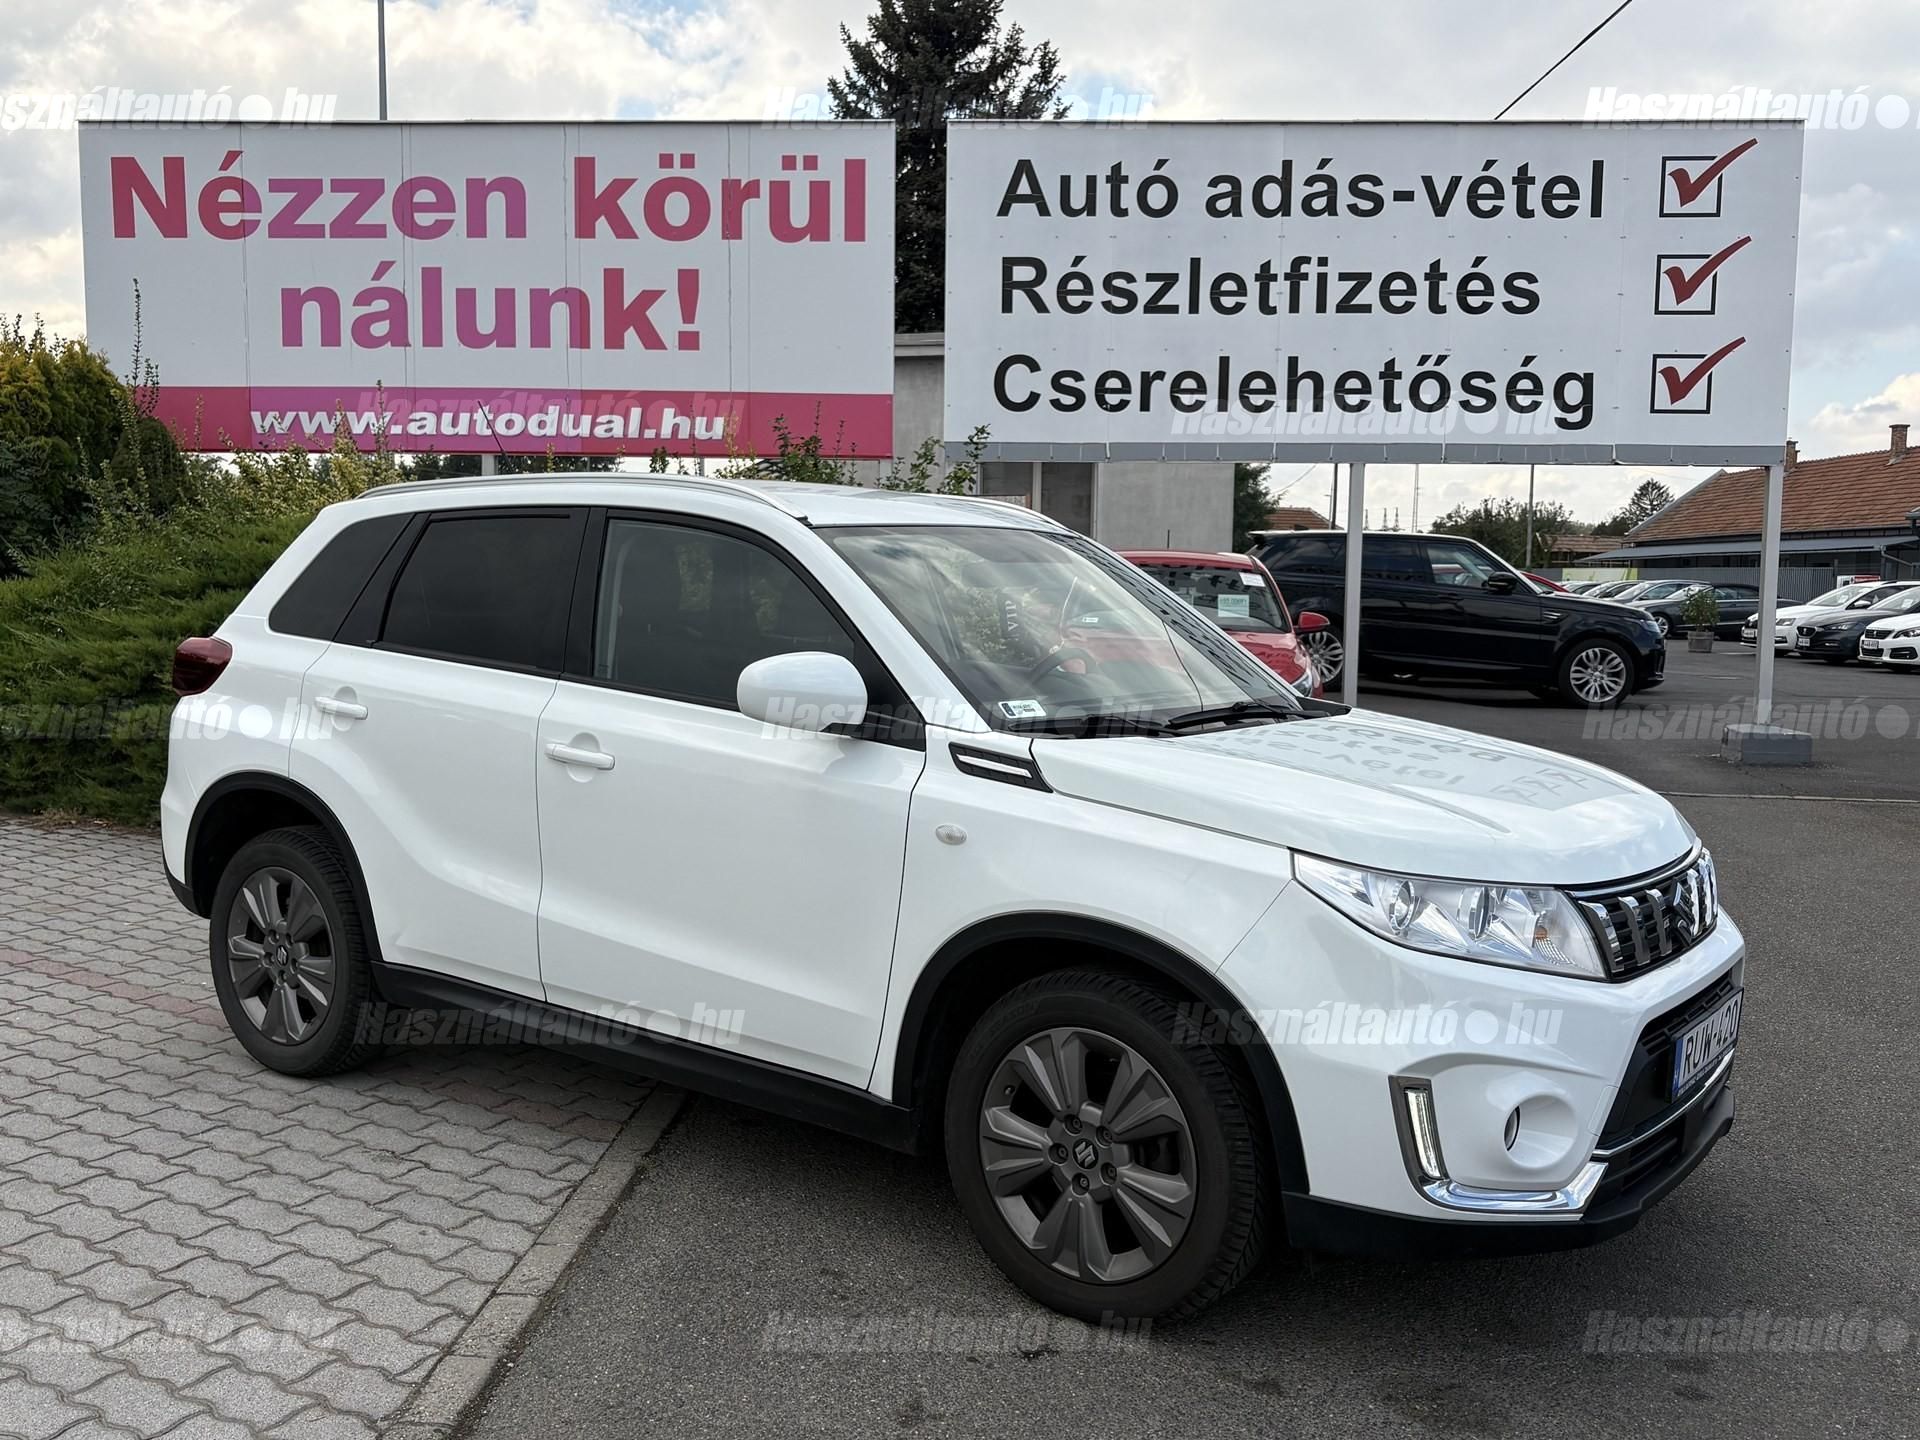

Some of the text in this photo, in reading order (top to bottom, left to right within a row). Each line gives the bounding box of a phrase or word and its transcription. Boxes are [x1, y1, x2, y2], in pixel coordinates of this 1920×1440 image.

[110, 150, 867, 244] Nézzen körül
[996, 157, 1604, 219] Autó adás-vétel
[281, 260, 701, 352] nálunk!
[1001, 255, 1540, 316] Részletfizetés
[250, 405, 725, 441] www.autodual.hu
[993, 353, 1594, 431] Cserelehetőség
[1682, 997, 1739, 1079] RUW-420
